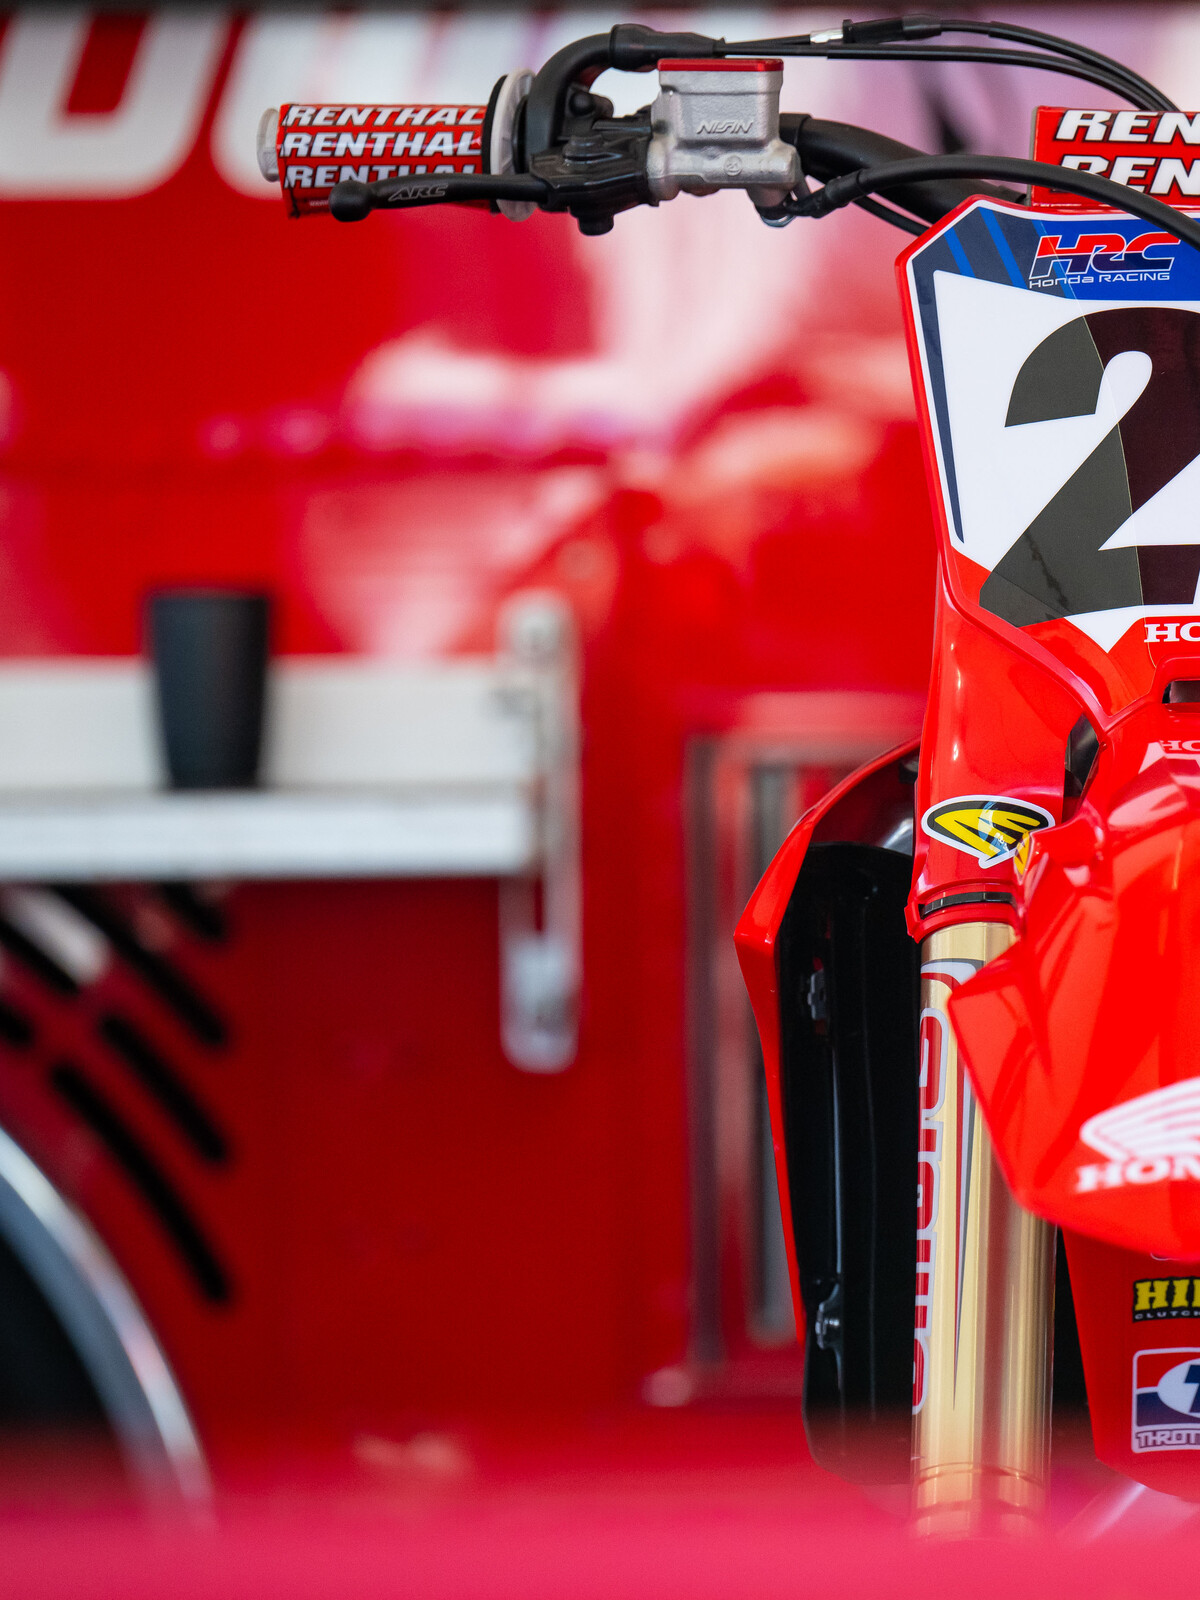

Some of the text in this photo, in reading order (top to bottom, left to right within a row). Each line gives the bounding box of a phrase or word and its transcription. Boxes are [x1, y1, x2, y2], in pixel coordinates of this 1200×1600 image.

[281, 105, 485, 127] RENTHAL
[280, 131, 482, 158] RENTHAL
[388, 183, 449, 202] ARC
[1029, 231, 1182, 280] HRC
[1029, 272, 1171, 289] Honda RACING
